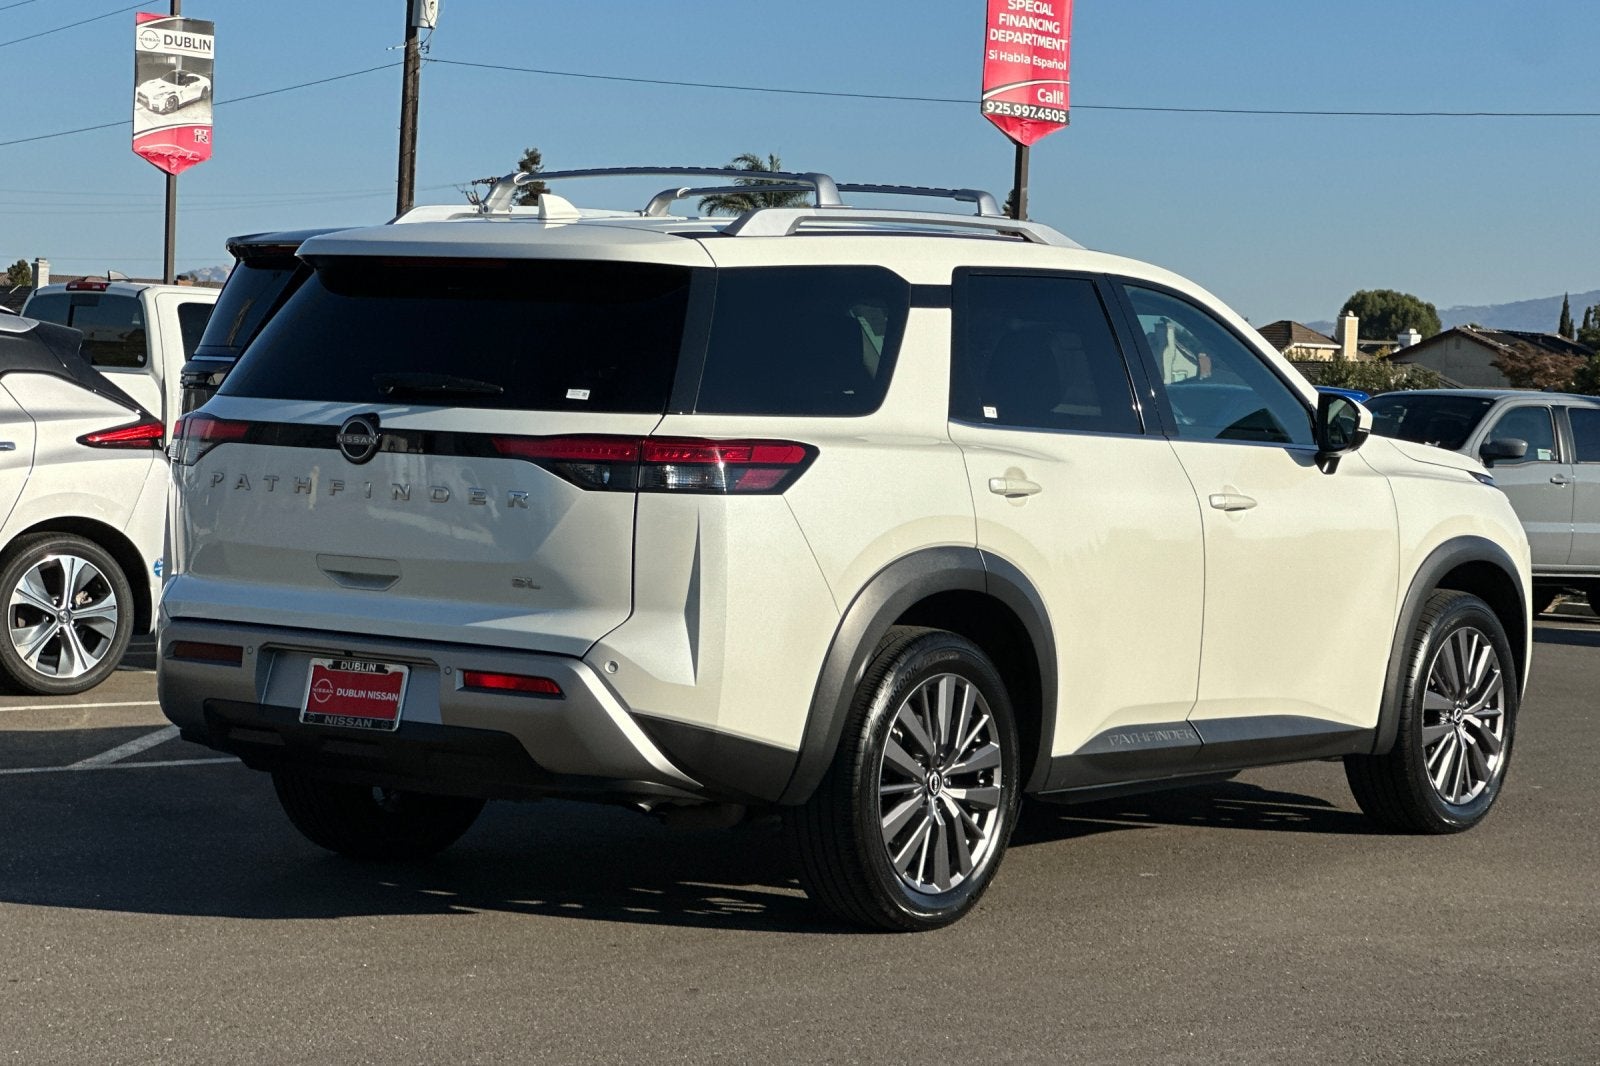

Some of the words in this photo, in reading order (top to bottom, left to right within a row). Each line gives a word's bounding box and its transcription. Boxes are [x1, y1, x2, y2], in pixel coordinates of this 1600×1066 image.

[1007, 0, 1055, 17] SPECIAL
[998, 13, 1060, 34] FINANCING
[163, 34, 212, 51] DUBLIN
[989, 28, 1068, 52] DEPARTMENT
[988, 49, 998, 60] Si
[999, 51, 1031, 64] Habla
[1032, 55, 1067, 71] Español
[1037, 88, 1064, 105] Call!
[986, 101, 1066, 123] 925.997.4505
[336, 434, 377, 445] NISSAN
[209, 471, 530, 509] PATHFINDER
[511, 576, 542, 590] SL
[340, 661, 377, 672] DUBLIN
[336, 688, 366, 698] DUBLIN
[367, 690, 399, 702] NISSAN
[324, 715, 373, 728] NISSAN
[1107, 729, 1196, 746] PATHFINDER
